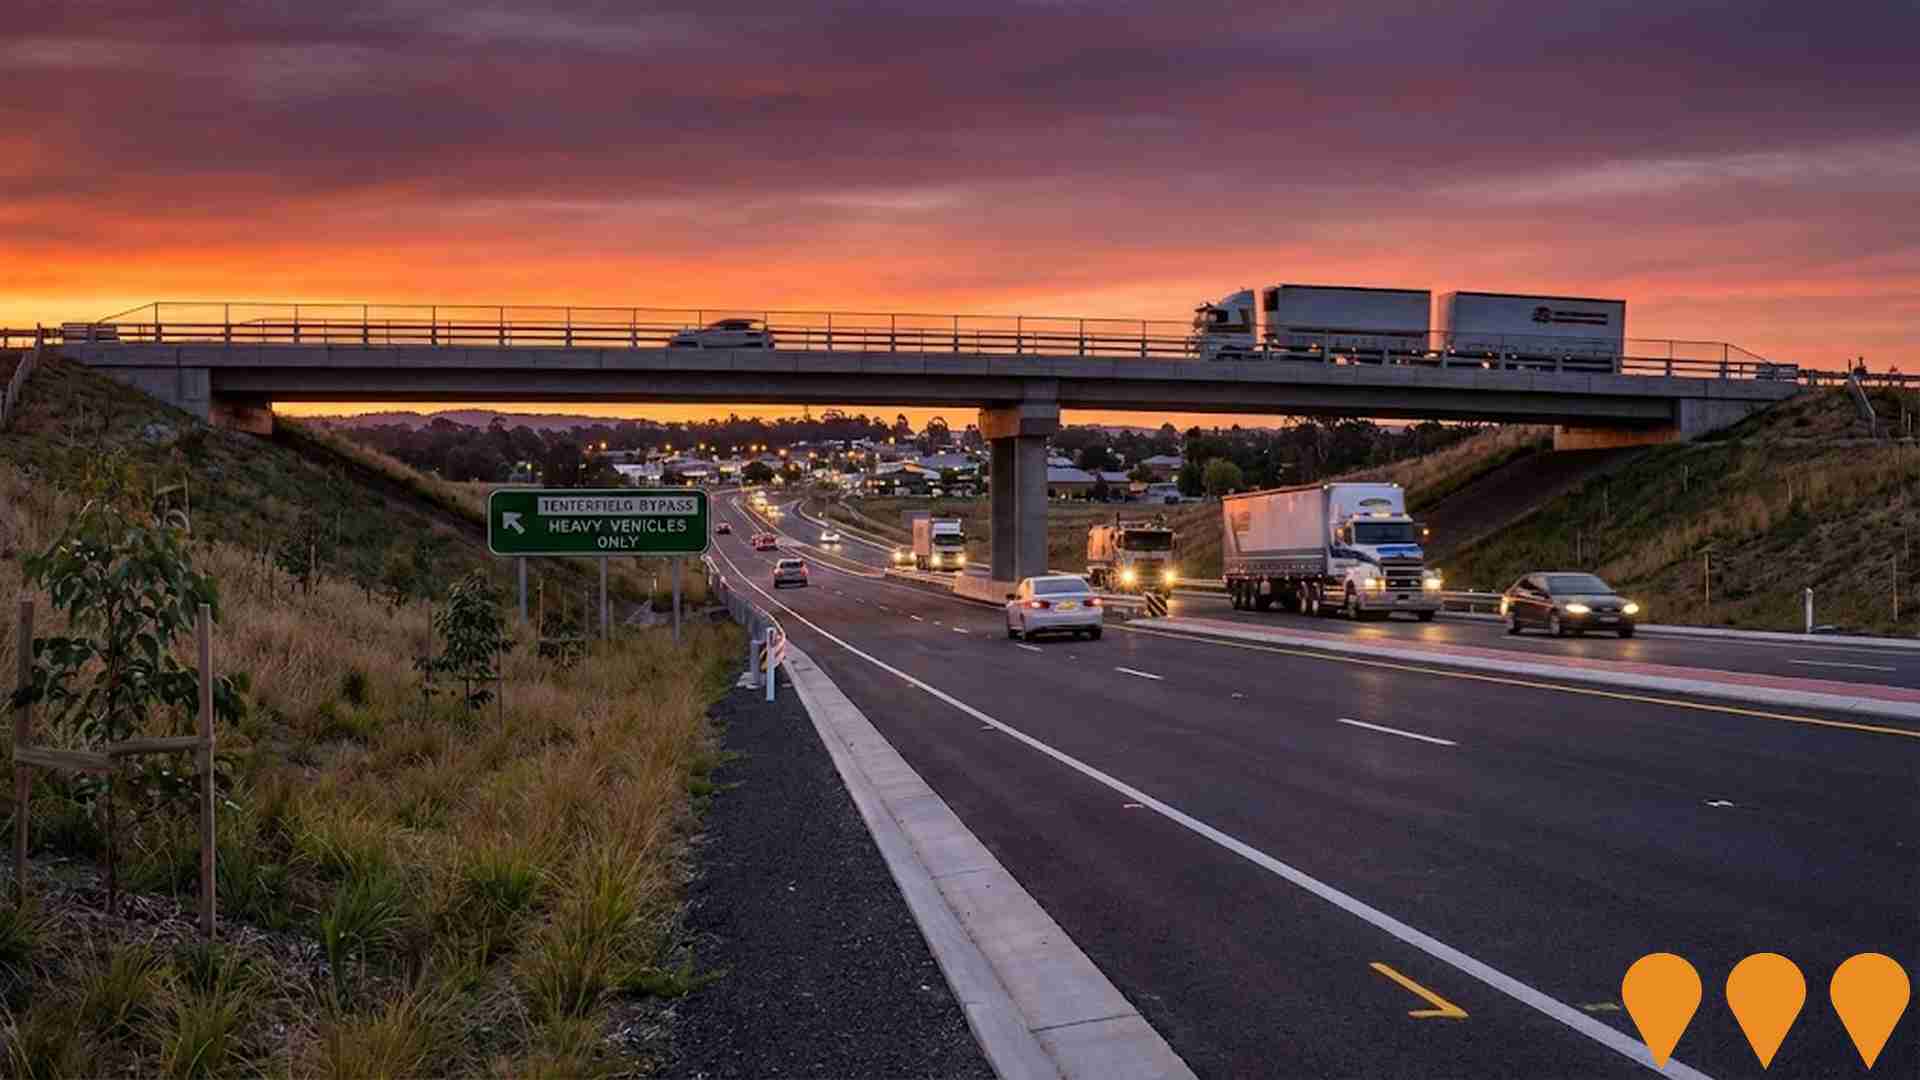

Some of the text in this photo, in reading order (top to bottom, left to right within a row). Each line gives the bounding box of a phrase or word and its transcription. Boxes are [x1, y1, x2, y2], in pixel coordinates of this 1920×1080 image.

[639, 500, 694, 512] BYPASS
[548, 519, 602, 532] HEAVY
[597, 536, 640, 549] ONLY
